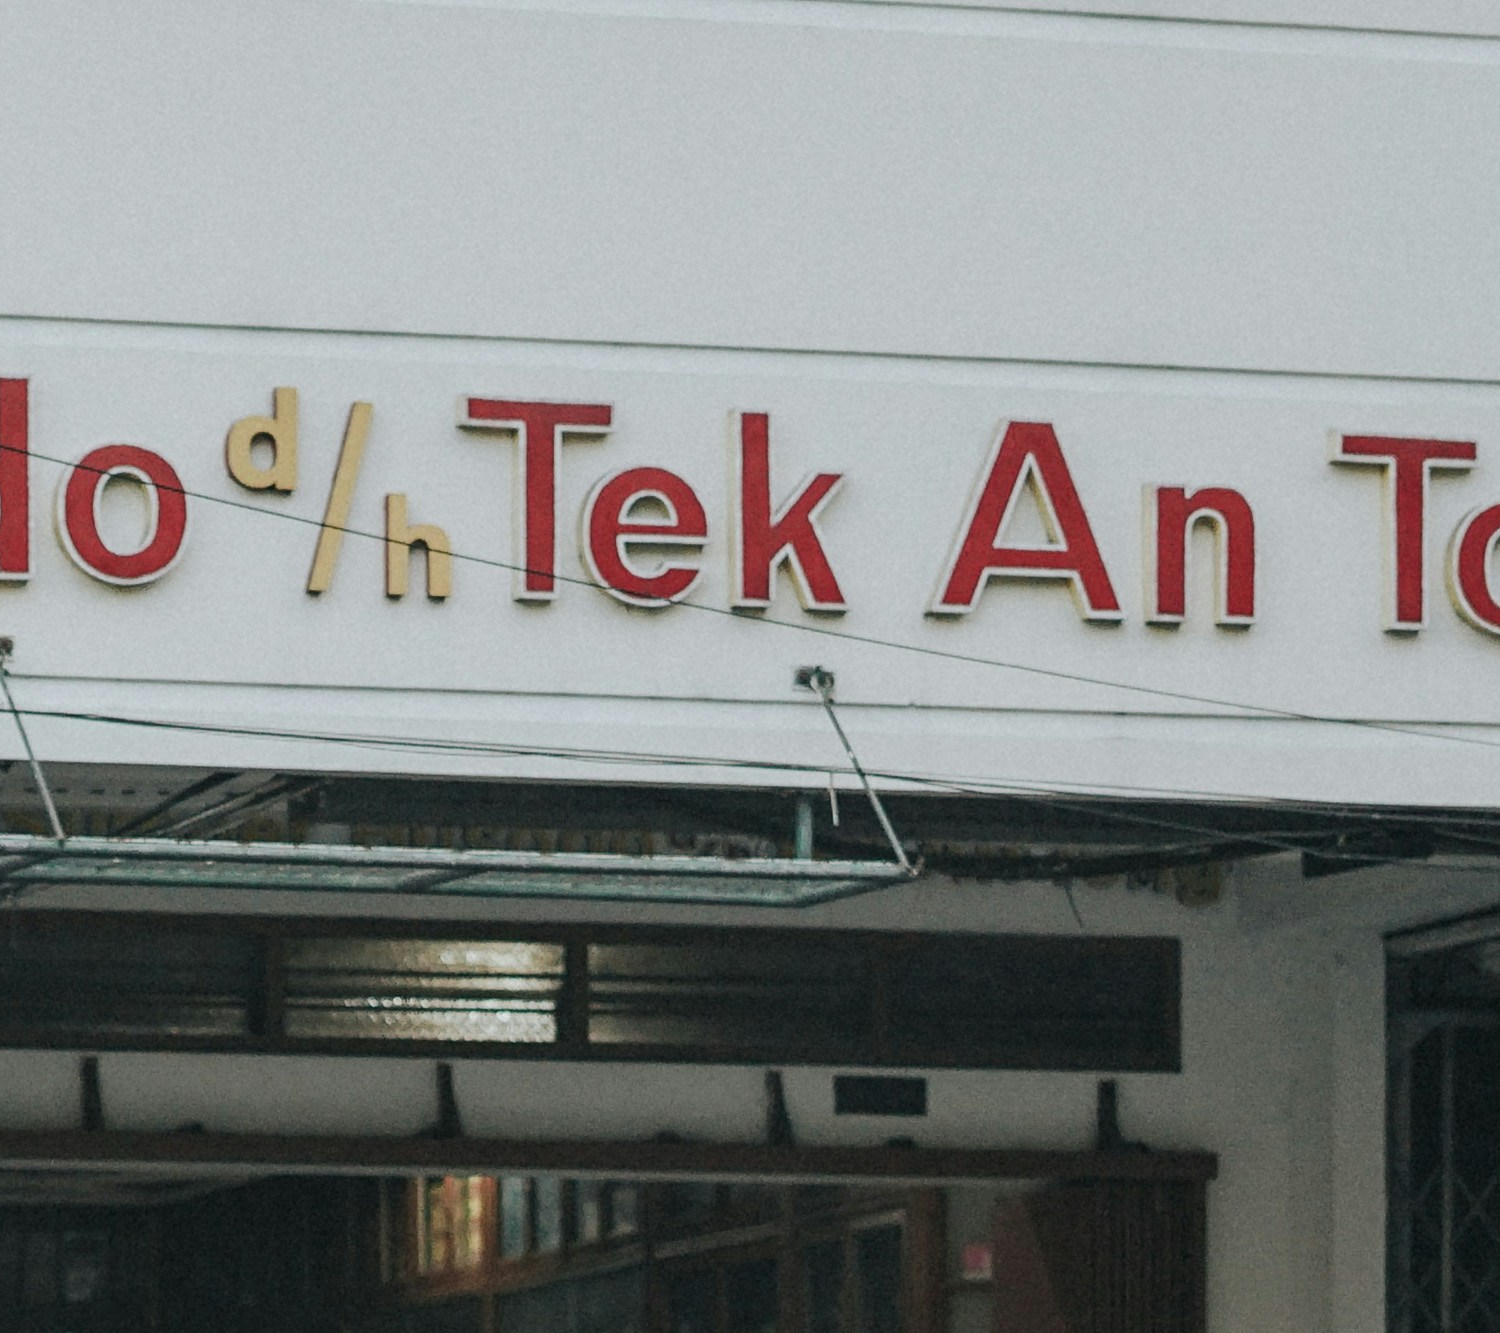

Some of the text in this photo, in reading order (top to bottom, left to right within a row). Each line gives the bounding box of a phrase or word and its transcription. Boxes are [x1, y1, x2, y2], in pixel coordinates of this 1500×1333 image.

[226, 386, 453, 599] d/h
[457, 395, 848, 614] Tek
[926, 417, 1257, 627] An
